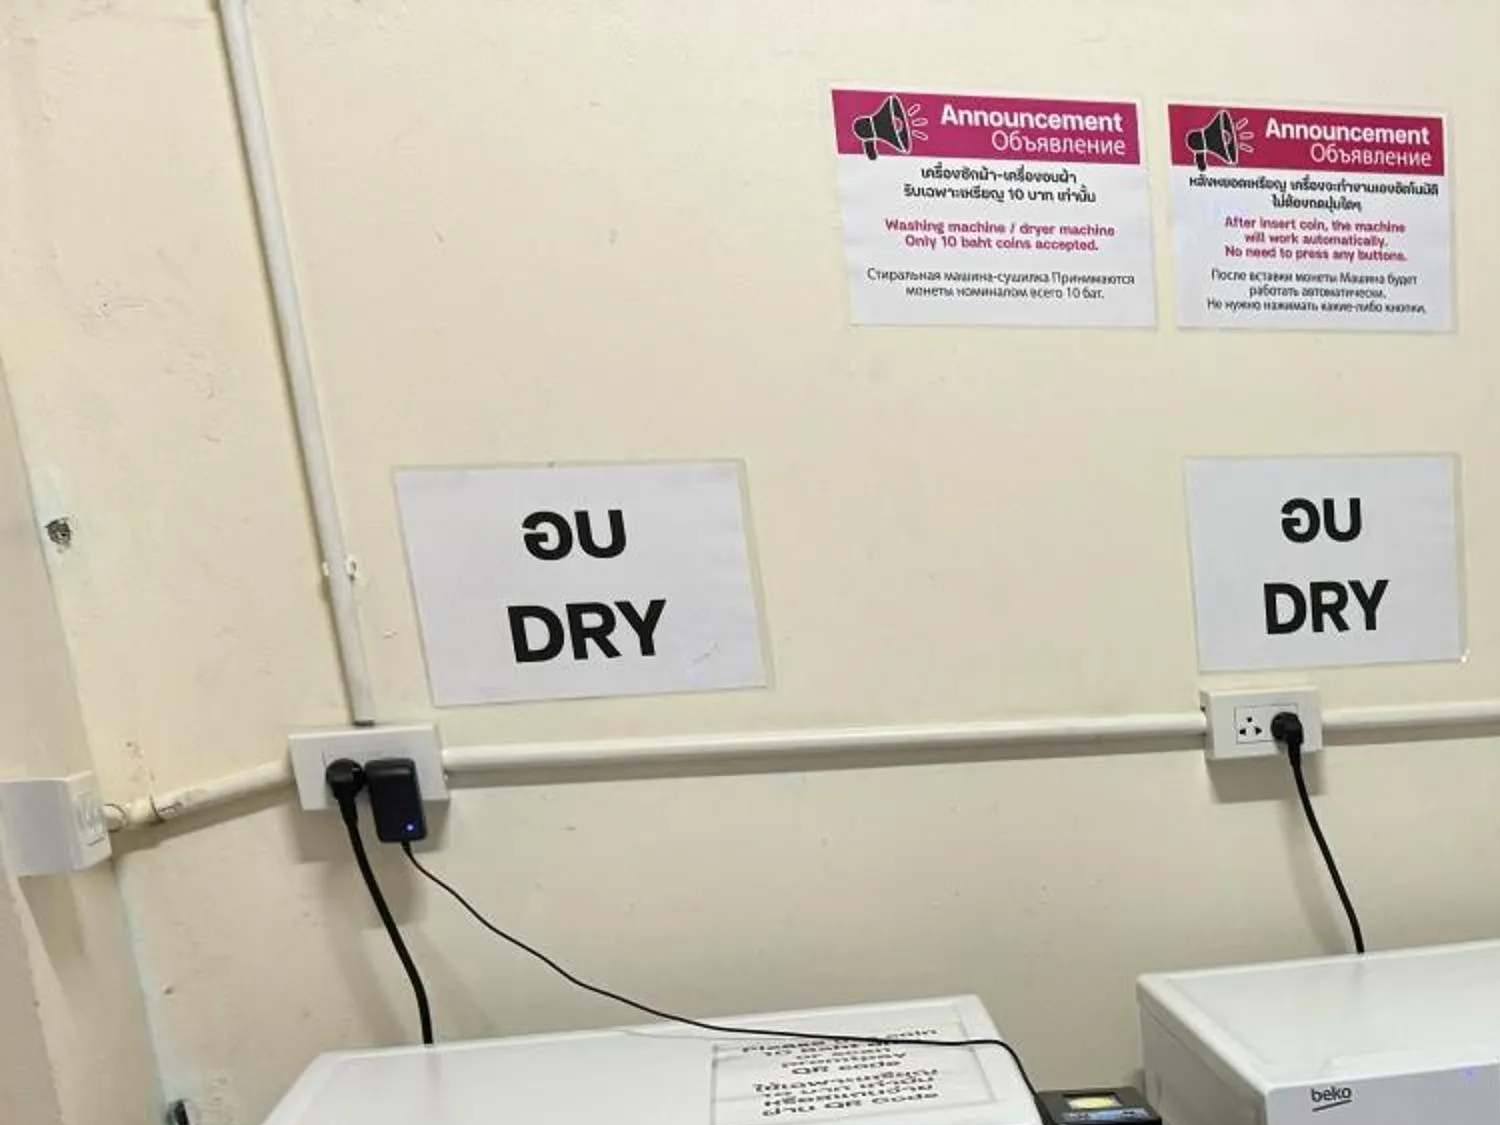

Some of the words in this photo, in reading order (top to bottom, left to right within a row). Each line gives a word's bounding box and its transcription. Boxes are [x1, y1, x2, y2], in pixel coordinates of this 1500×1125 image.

[941, 104, 1123, 132] Announcement
[1265, 118, 1430, 145] Announcement
[992, 130, 1126, 155] Объявление
[1310, 143, 1432, 167] Объявление
[1008, 188, 1024, 201] 10
[1028, 190, 1054, 202] บาท
[885, 218, 944, 235] Washing
[948, 222, 1005, 234] machine
[1020, 223, 1055, 239] dryer
[1059, 225, 1115, 237] machine
[1225, 217, 1256, 229] After
[1260, 218, 1296, 230] insert
[1299, 219, 1328, 232] coin,
[1332, 220, 1351, 231] the
[1355, 221, 1405, 233] machine
[905, 235, 936, 250] Only
[941, 236, 957, 247] 10
[961, 236, 992, 249] baht
[996, 237, 1031, 250] coins
[1035, 239, 1099, 252] accepted.
[1244, 233, 1265, 244] will
[1269, 233, 1298, 245] work
[1302, 234, 1388, 249] automatically.
[1225, 246, 1243, 258] No
[1246, 247, 1276, 258] need
[1280, 248, 1292, 258] to
[1296, 249, 1329, 262] press
[1333, 250, 1354, 263] any
[1358, 250, 1408, 262] buttons.
[867, 268, 941, 283] Стиральная
[1052, 271, 1136, 286] Принимаются
[1211, 270, 1246, 282] После
[905, 285, 954, 297] монеты
[1066, 288, 1080, 298] 10
[1281, 498, 1362, 543] อบ
[521, 509, 626, 560] อบ
[1263, 579, 1389, 635] DRY
[506, 599, 666, 663] DRY
[1311, 1086, 1352, 1103] beko
